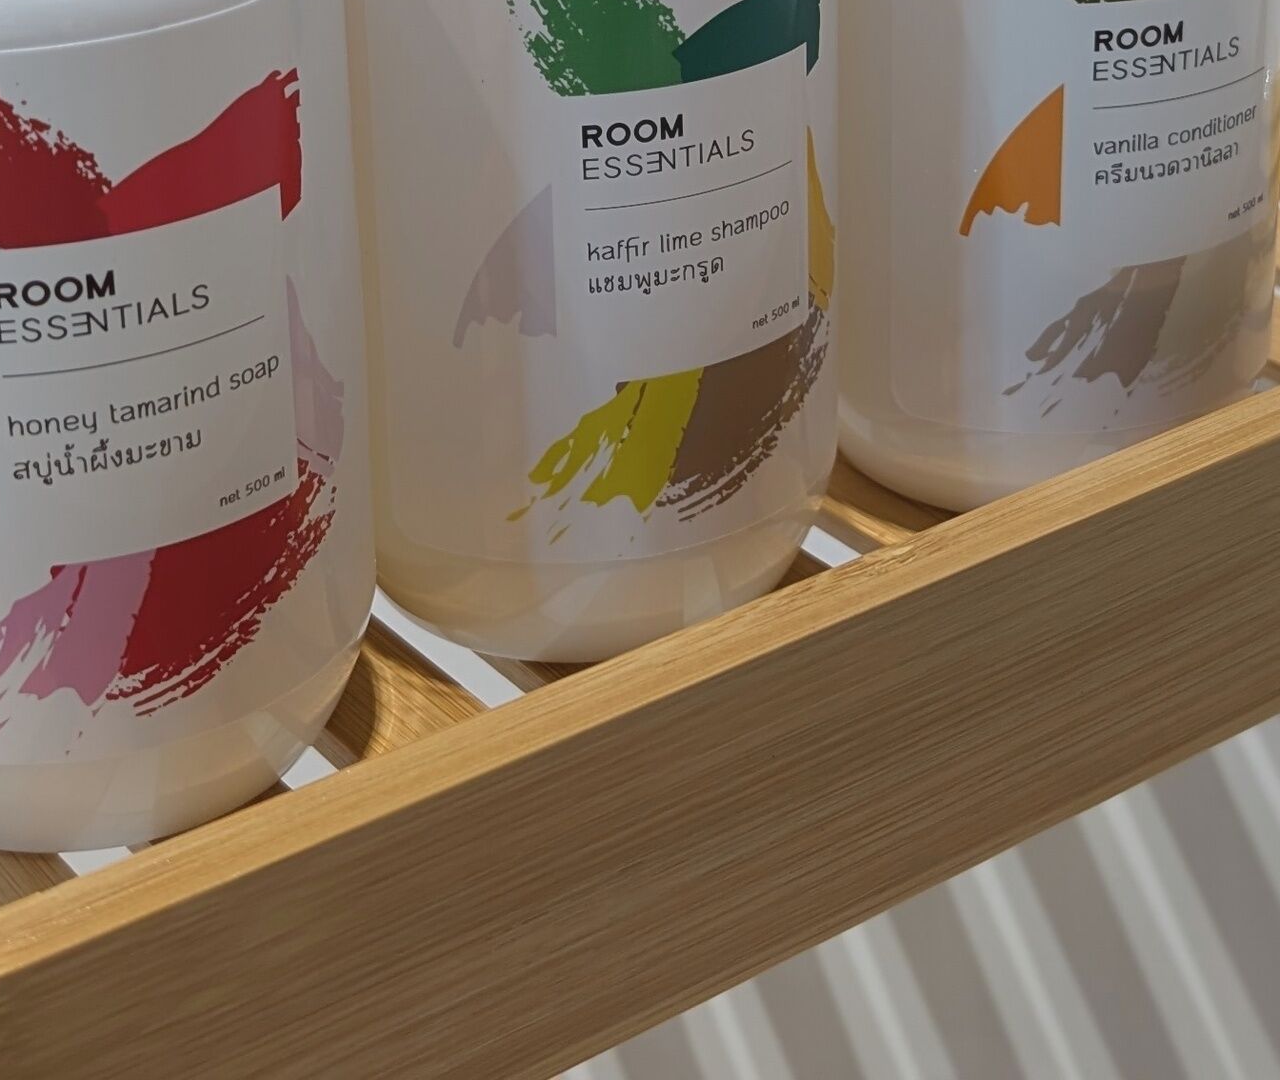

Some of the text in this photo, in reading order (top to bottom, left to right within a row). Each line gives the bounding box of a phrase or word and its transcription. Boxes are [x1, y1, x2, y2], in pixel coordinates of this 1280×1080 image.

[1093, 36, 1240, 81] ESSENTIALS
[1094, 21, 1184, 52] ROOM
[581, 113, 684, 148] ROOM
[1093, 105, 1257, 156] vanilla conditioner
[583, 129, 755, 180] ESSENTIALS
[1094, 142, 1240, 186] ครีมนวดวานิลลา
[587, 200, 790, 262] kaffir lime shampoo
[588, 256, 724, 295] แชมพูมะกรูด
[752, 314, 769, 329] net
[771, 302, 790, 321] 500
[8, 355, 280, 437] honey tamarind soap
[13, 428, 202, 485] สบู่น้ำผึ้งมะขาม
[219, 466, 286, 507] net 500 ml
